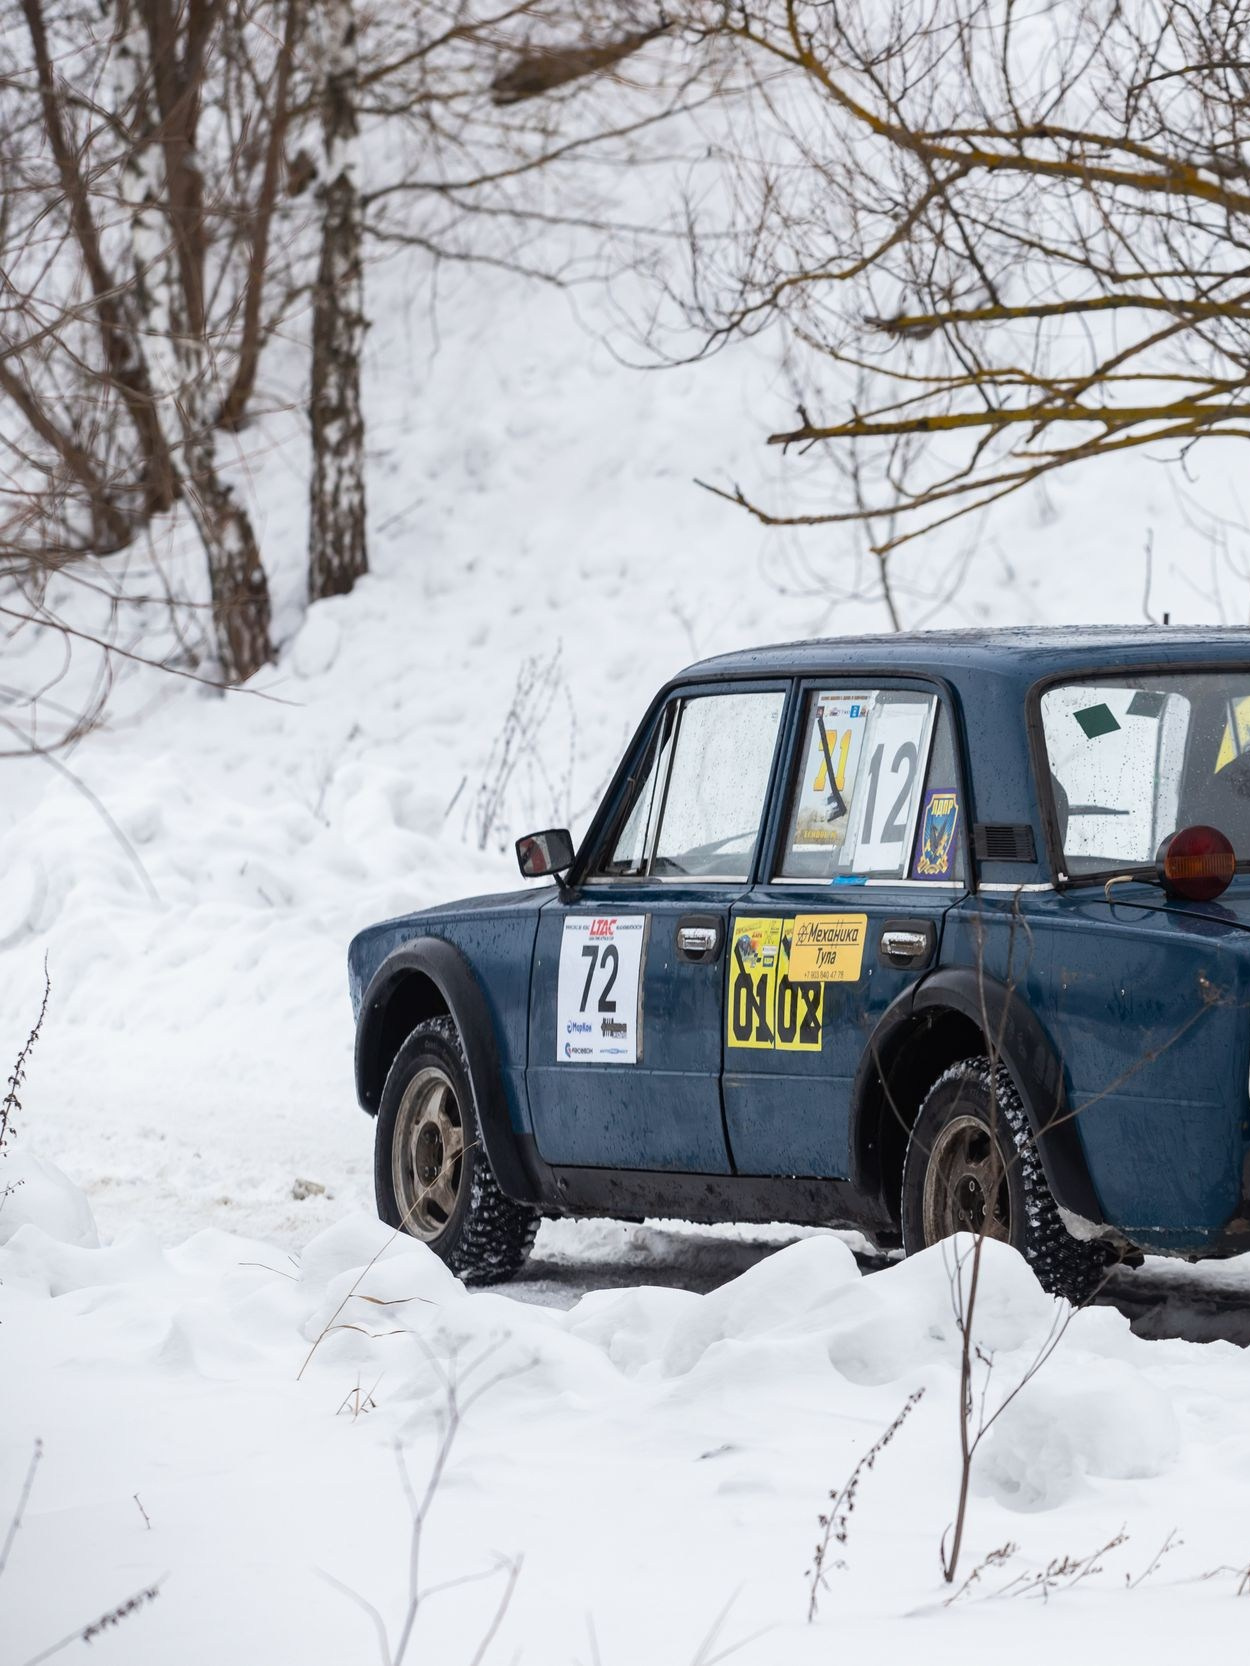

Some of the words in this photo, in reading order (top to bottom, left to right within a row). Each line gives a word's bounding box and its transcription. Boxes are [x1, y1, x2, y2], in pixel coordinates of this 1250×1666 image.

[861, 741, 919, 845] 12
[931, 799, 954, 816] ЛДПР
[808, 923, 859, 942] Механика
[816, 948, 837, 968] Тула
[579, 944, 619, 1012] 72
